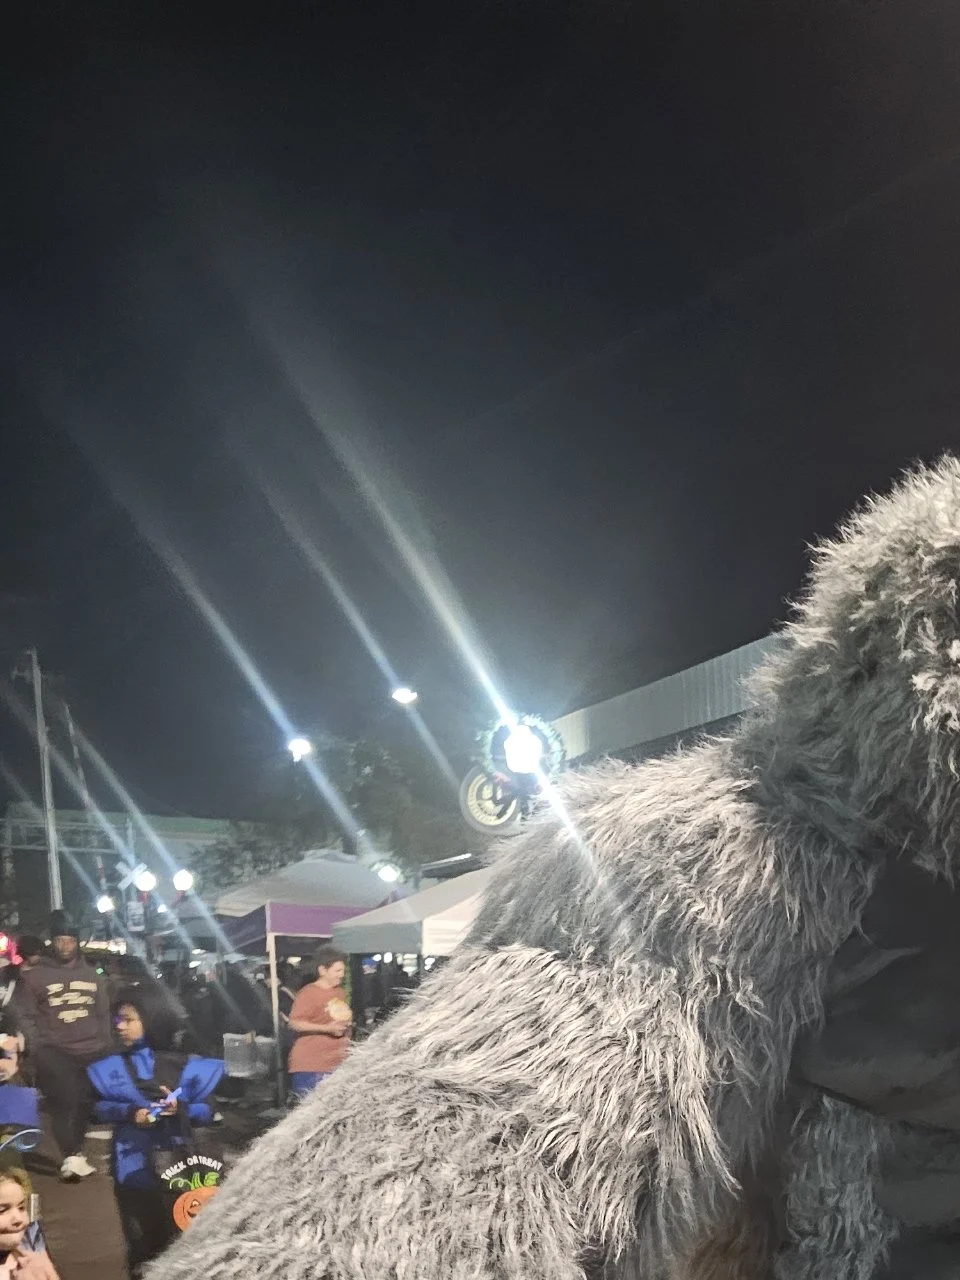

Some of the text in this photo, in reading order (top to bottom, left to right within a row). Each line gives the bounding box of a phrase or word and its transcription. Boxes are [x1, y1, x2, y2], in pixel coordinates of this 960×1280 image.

[161, 1155, 222, 1180] TRICK OR TREAT
